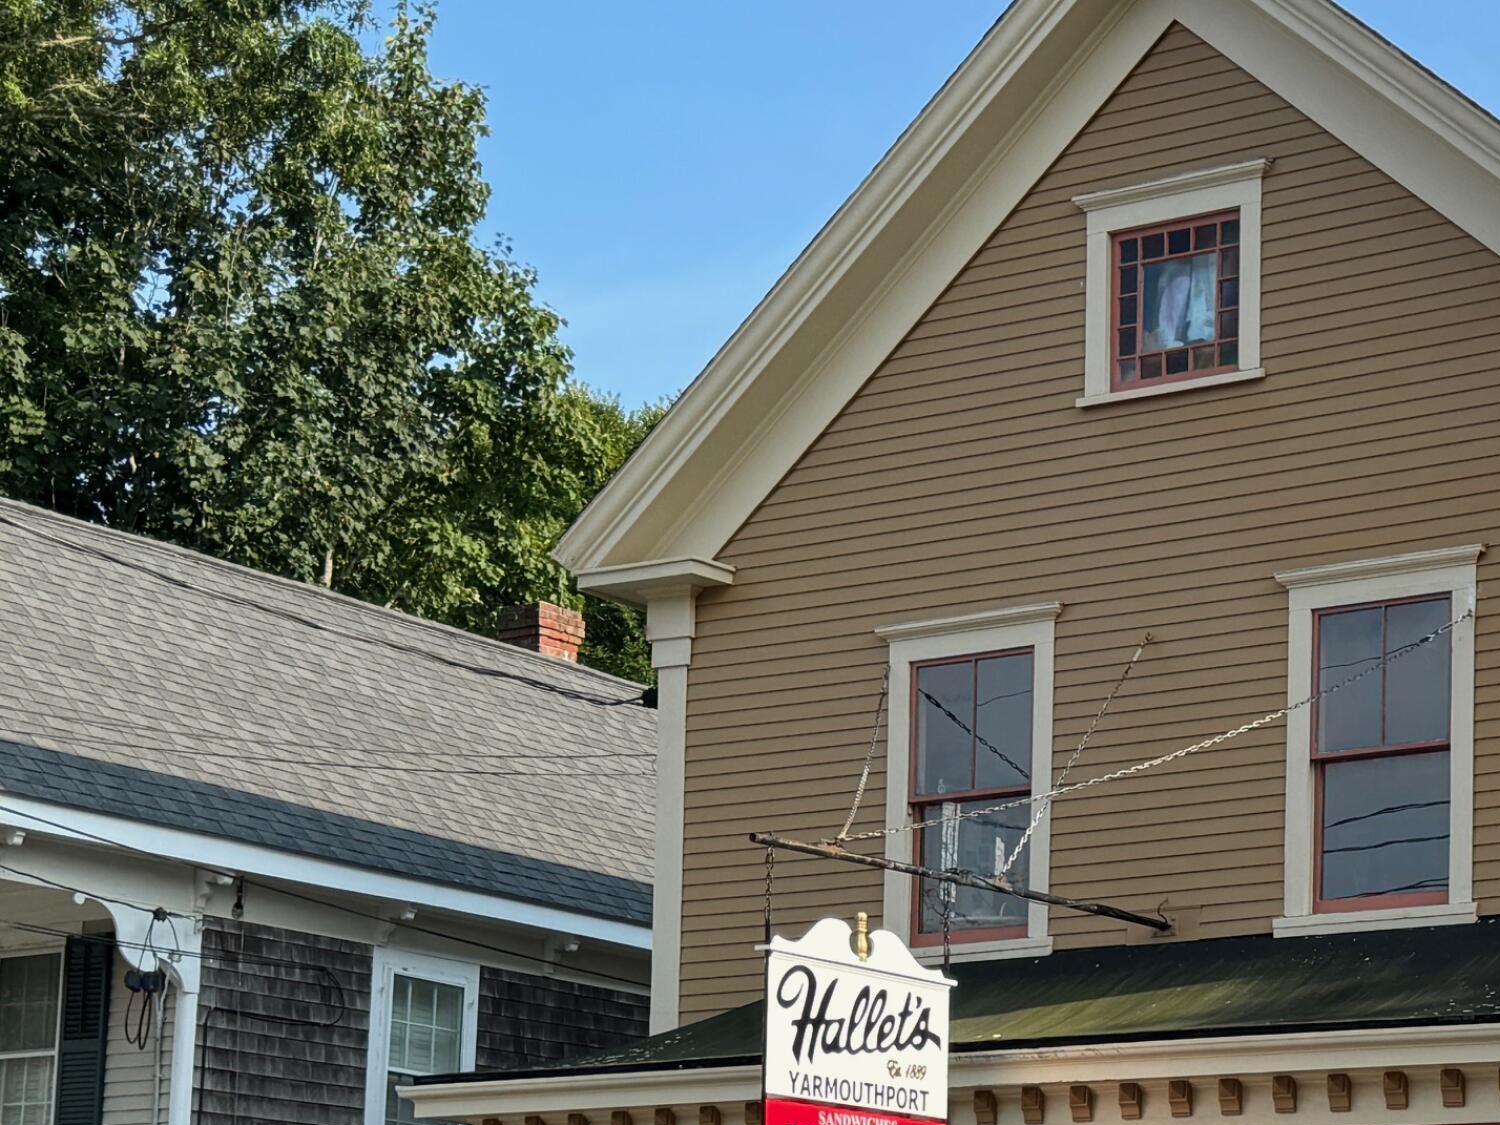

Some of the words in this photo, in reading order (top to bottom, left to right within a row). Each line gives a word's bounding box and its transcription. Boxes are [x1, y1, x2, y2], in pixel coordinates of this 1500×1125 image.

[776, 965, 942, 1065] Hallet's
[788, 1070, 930, 1112] YARMOUTHPORT
[906, 1063, 927, 1081] 1889
